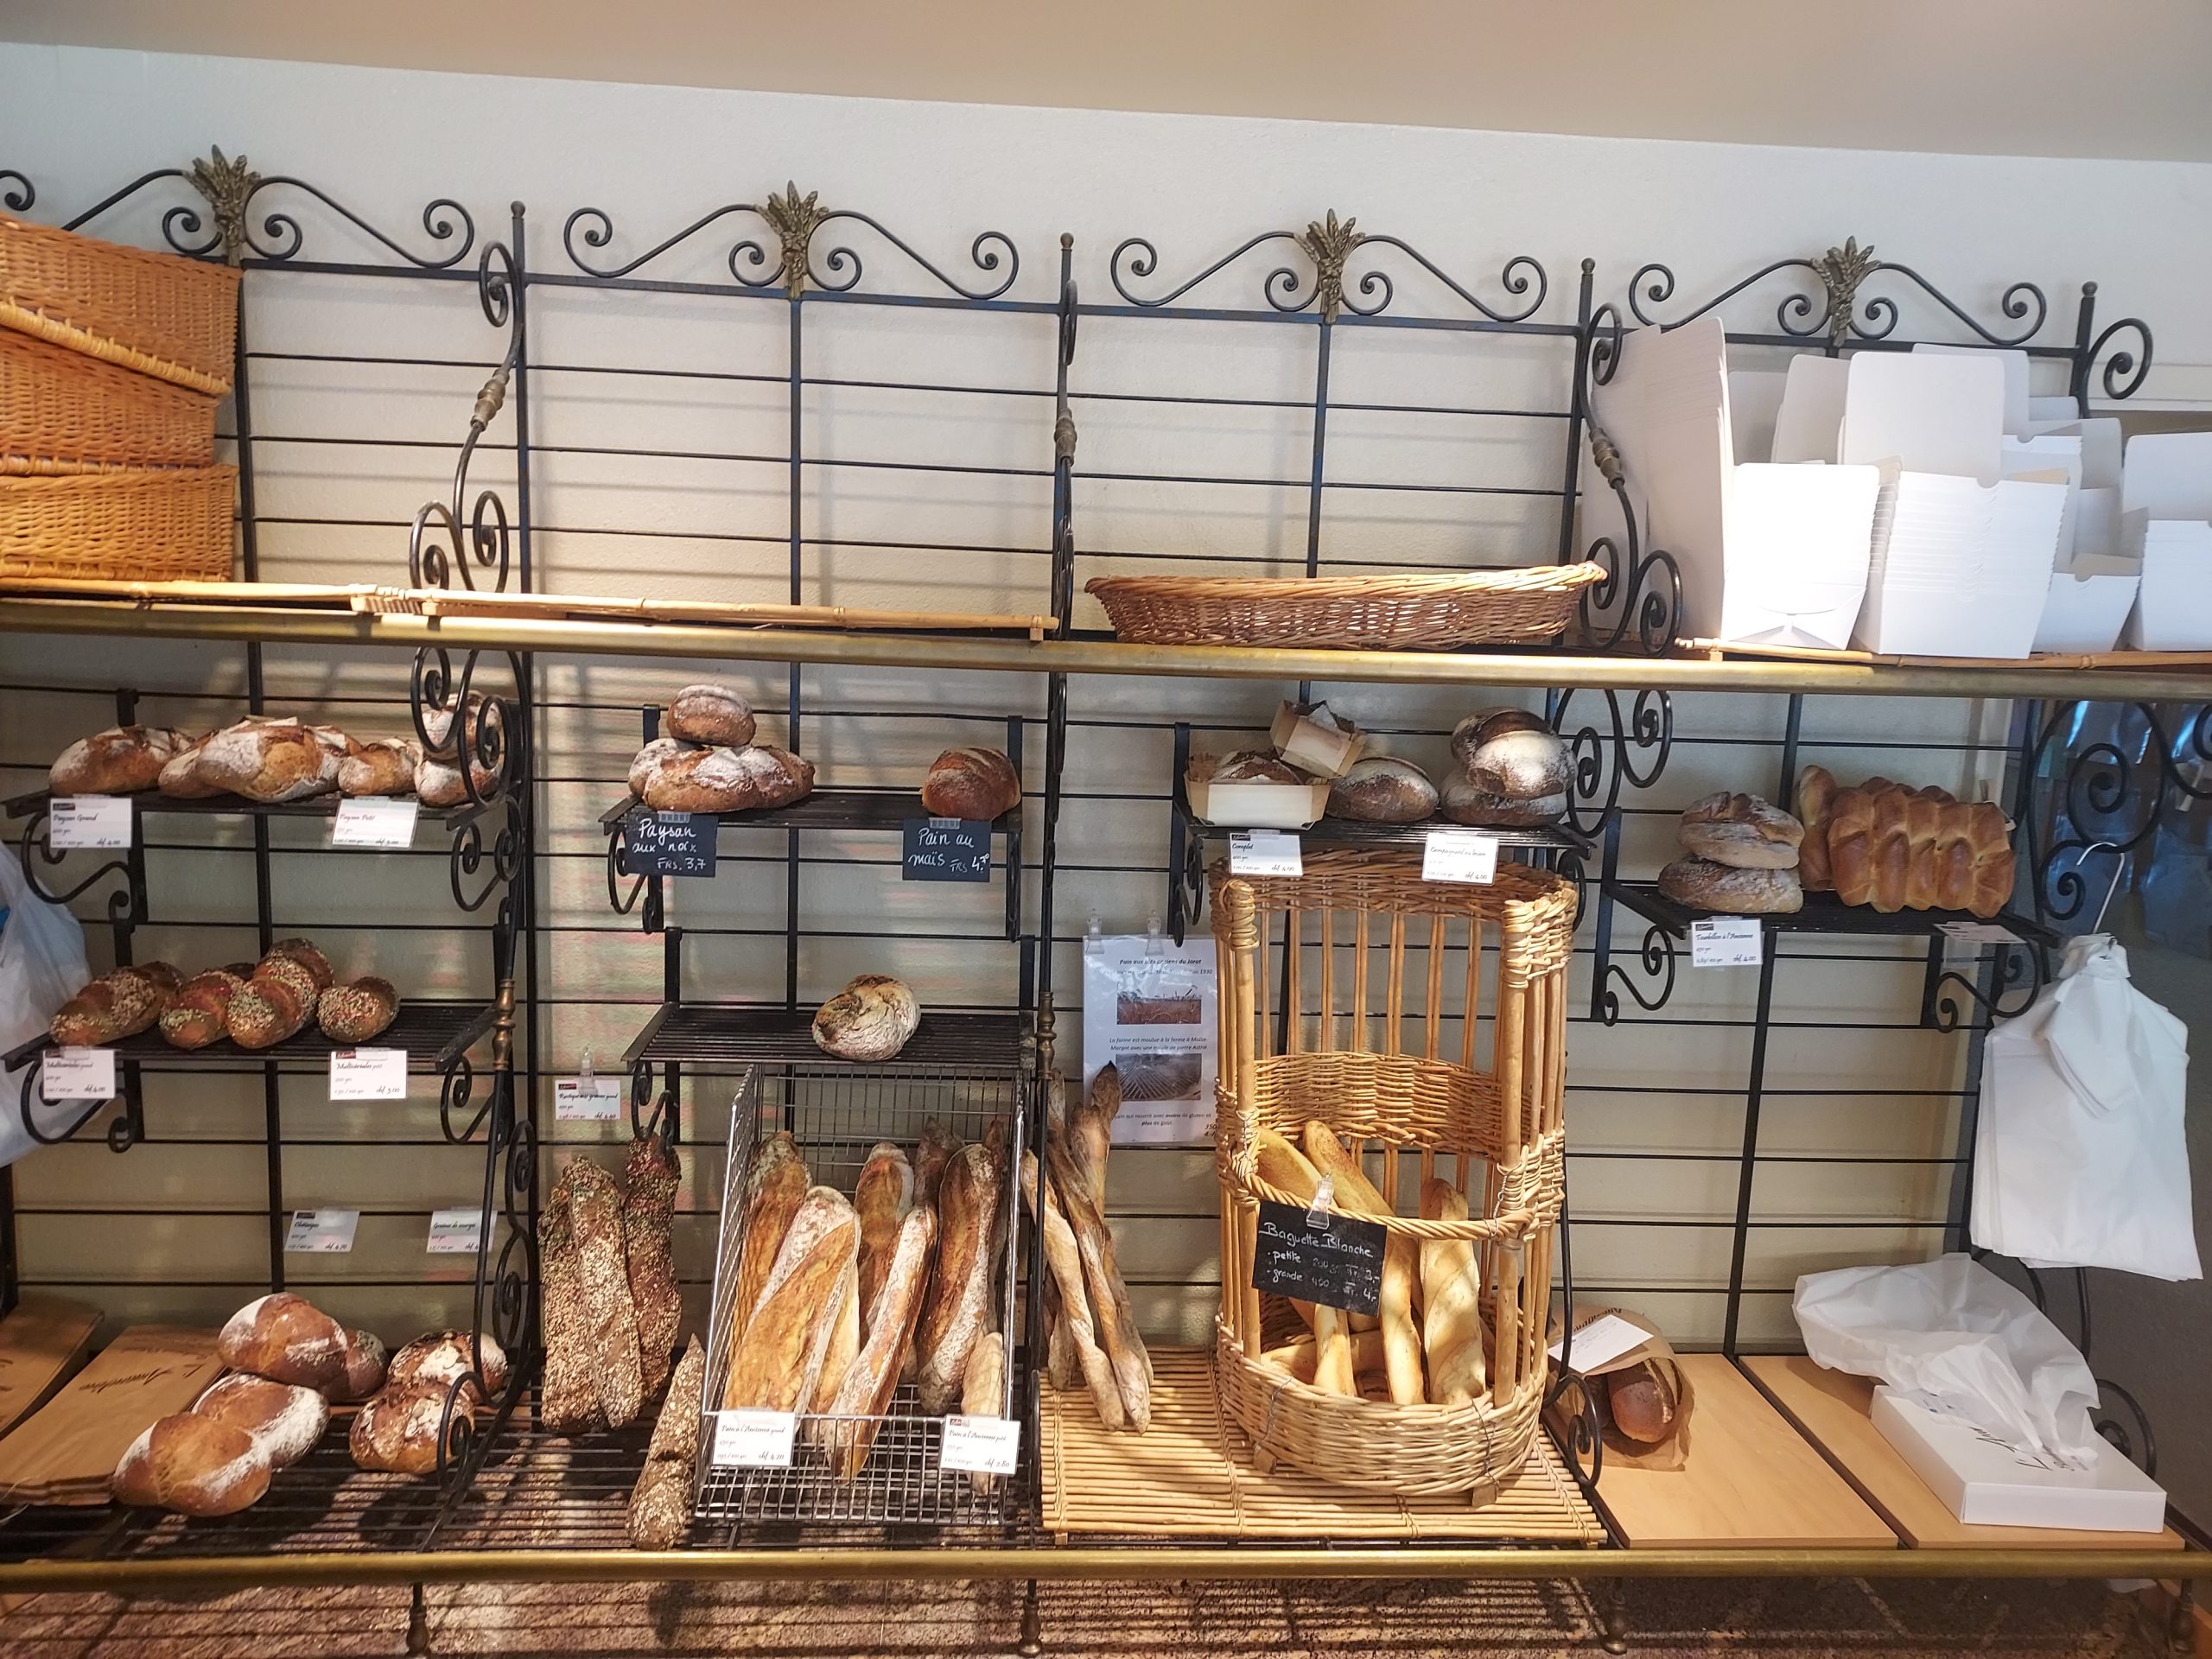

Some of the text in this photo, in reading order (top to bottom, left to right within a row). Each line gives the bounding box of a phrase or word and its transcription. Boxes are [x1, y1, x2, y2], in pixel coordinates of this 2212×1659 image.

[639, 817, 696, 846] Paysan
[918, 827, 975, 849] Pain au
[632, 841, 696, 853] aux noix
[1232, 842, 1254, 852] Complet
[907, 851, 946, 867] maïs
[1259, 1222, 1373, 1258] Baguette Blanche
[1273, 1251, 1301, 1264] petite
[1272, 1268, 1303, 1283] grande
